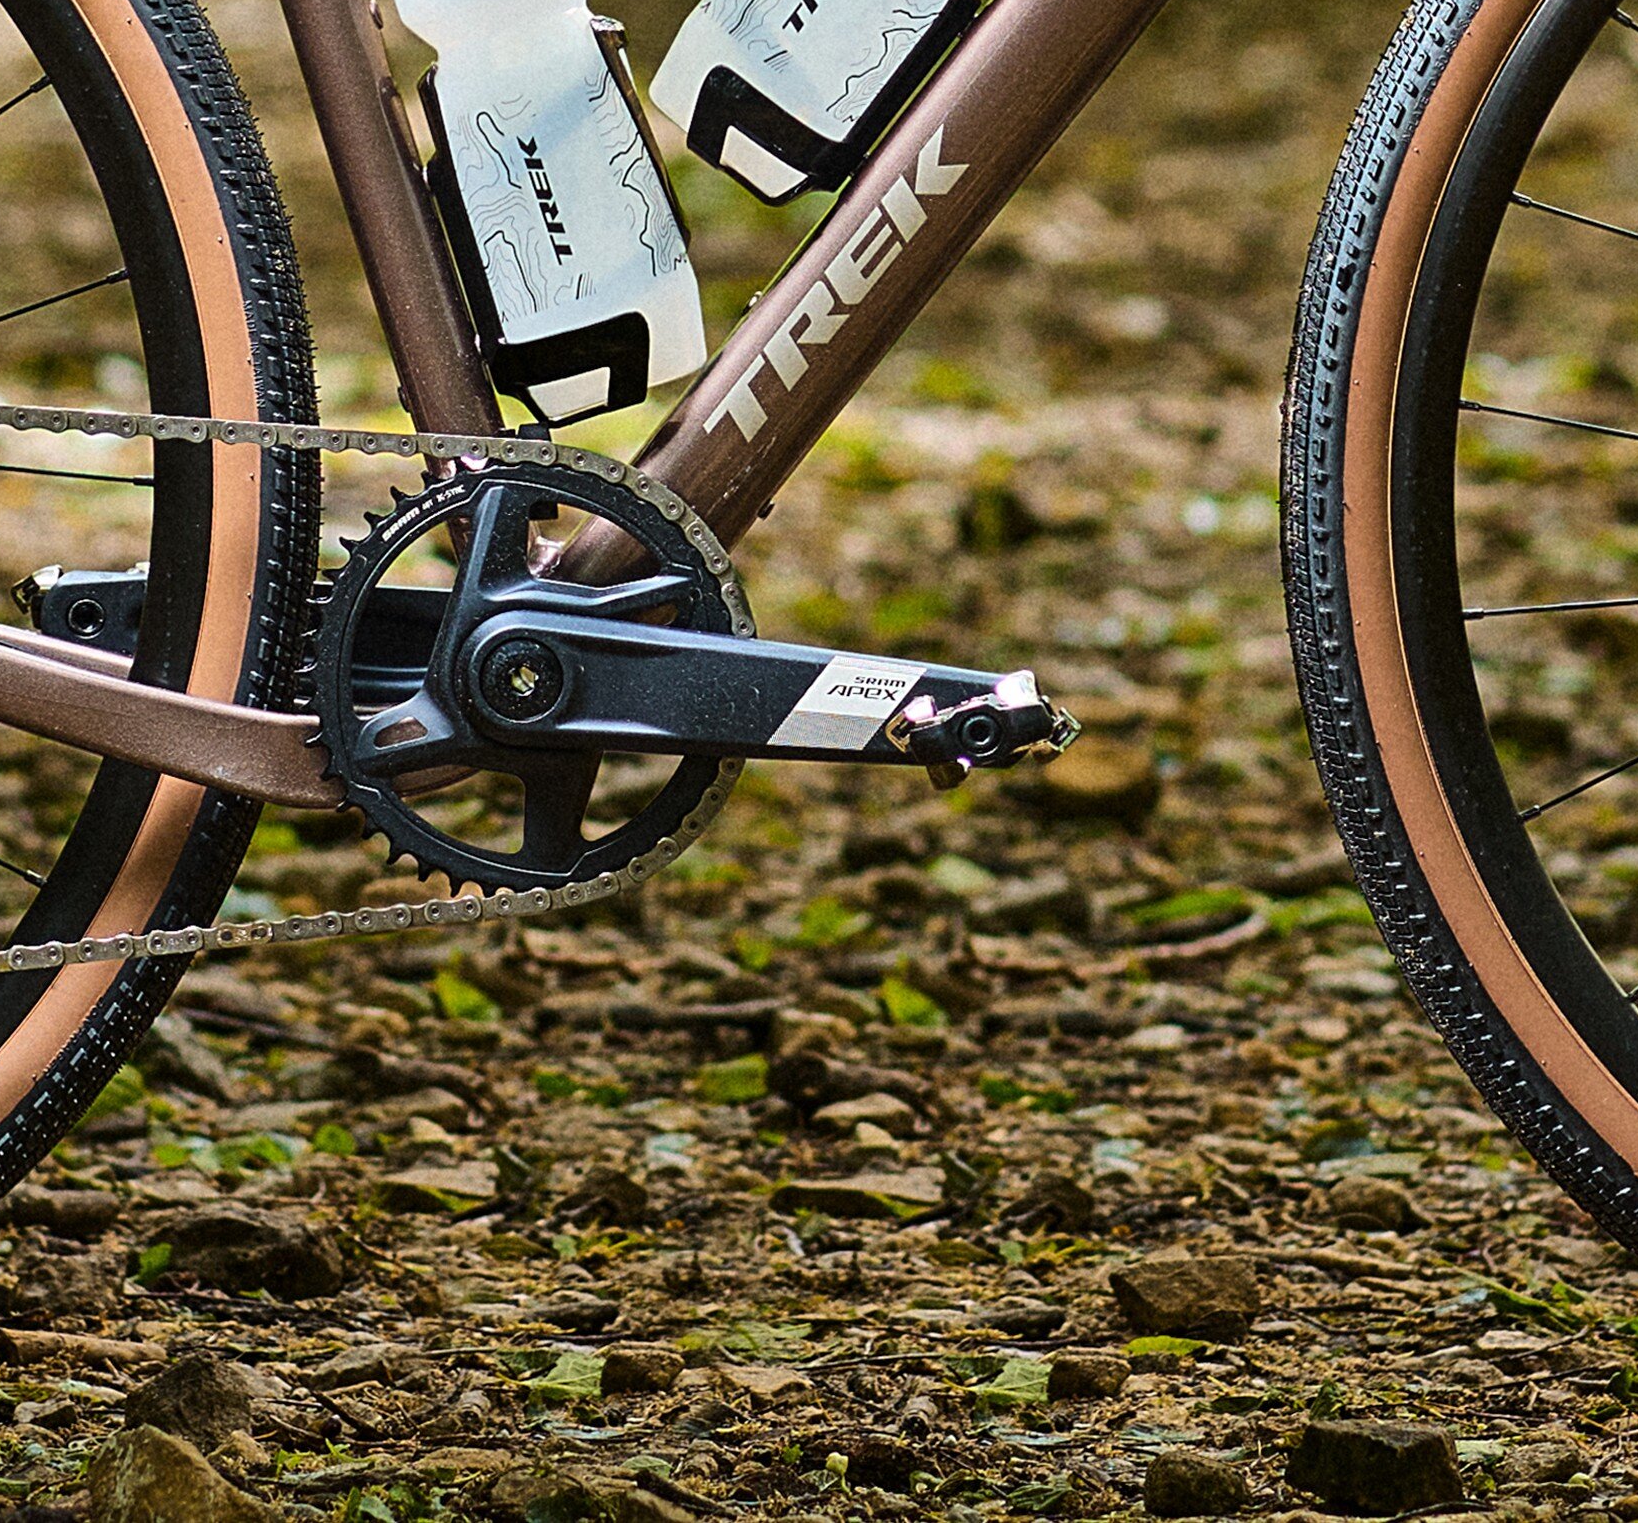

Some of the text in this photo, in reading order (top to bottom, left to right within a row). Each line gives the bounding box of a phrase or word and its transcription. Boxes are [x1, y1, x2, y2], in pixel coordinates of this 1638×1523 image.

[516, 136, 573, 266] TREK
[703, 123, 970, 443] TREK
[249, 340, 262, 355] IN
[251, 359, 266, 408] TAIWAN
[381, 506, 421, 542] SRAM
[827, 684, 898, 701] APEX
[854, 676, 906, 688] SRAM
